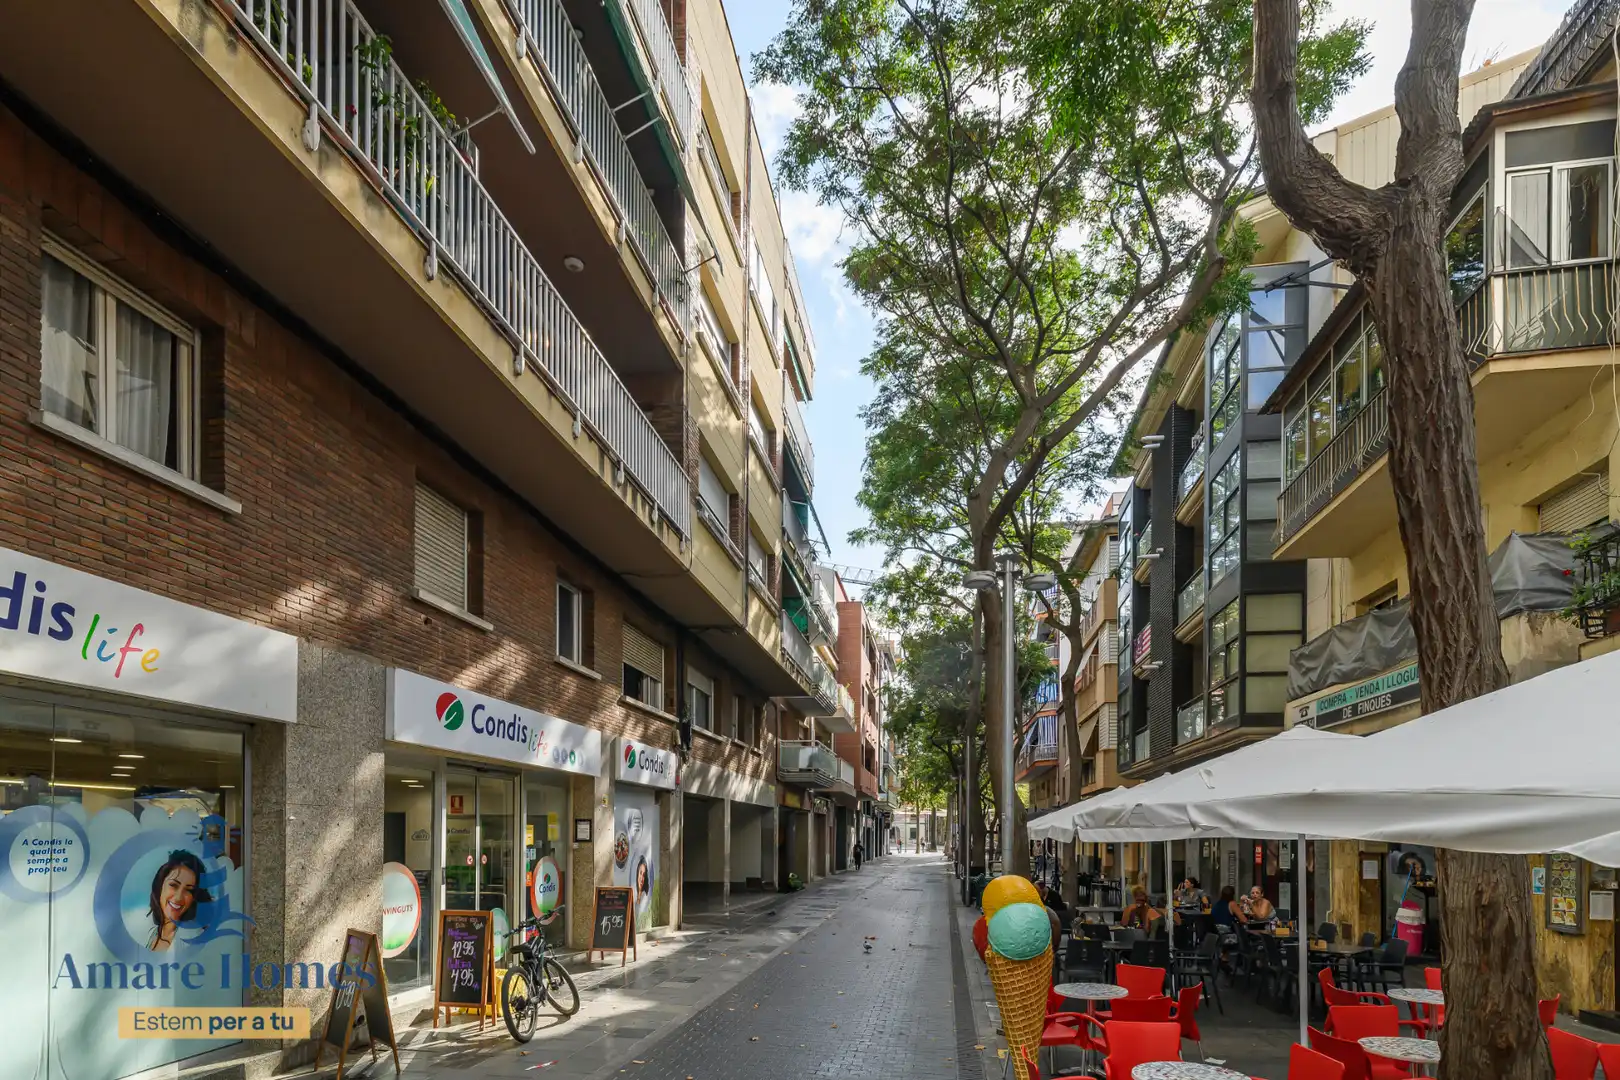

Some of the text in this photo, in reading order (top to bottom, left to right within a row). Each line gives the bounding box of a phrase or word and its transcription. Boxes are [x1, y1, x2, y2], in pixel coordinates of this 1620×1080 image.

[82, 614, 160, 679] life
[1320, 692, 1347, 711] COMPRA
[1355, 681, 1381, 699] VENDA
[1382, 678, 1386, 691] I
[1342, 693, 1392, 719] DE FINQUES
[471, 703, 549, 758] Condis life
[638, 749, 664, 774] Condis
[22, 838, 73, 846] A Condis la
[28, 867, 50, 875] prop
